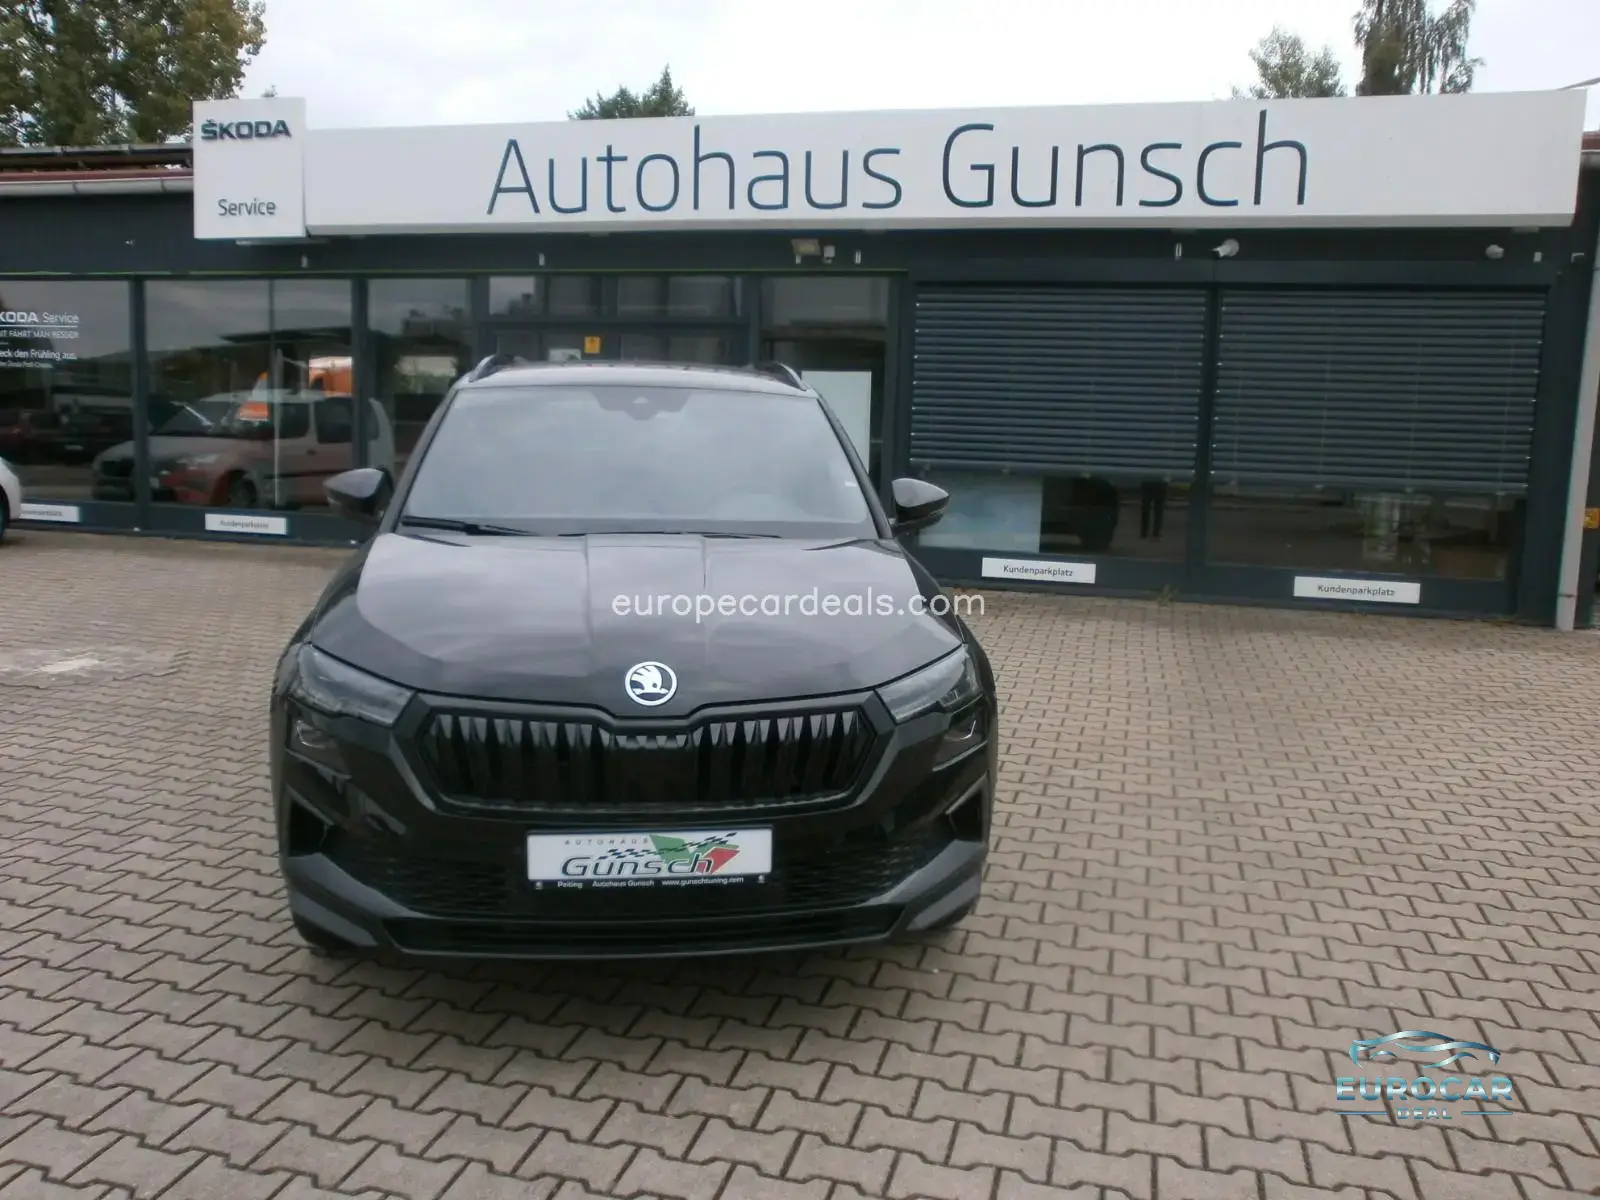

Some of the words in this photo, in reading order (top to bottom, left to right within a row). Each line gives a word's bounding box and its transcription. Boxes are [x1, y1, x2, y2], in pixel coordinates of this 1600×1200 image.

[200, 118, 292, 140] ŠKODA
[487, 125, 902, 216] Autohaus
[942, 109, 1308, 208] Gunsch
[218, 197, 276, 216] Service
[42, 312, 79, 324] Service
[1003, 565, 1073, 577] Kundenparkplatz
[1318, 584, 1395, 597] Kundenparkplatz
[564, 837, 649, 846] AUTOHAUS
[561, 852, 714, 877] Gunsch
[592, 880, 627, 888] Autohaus
